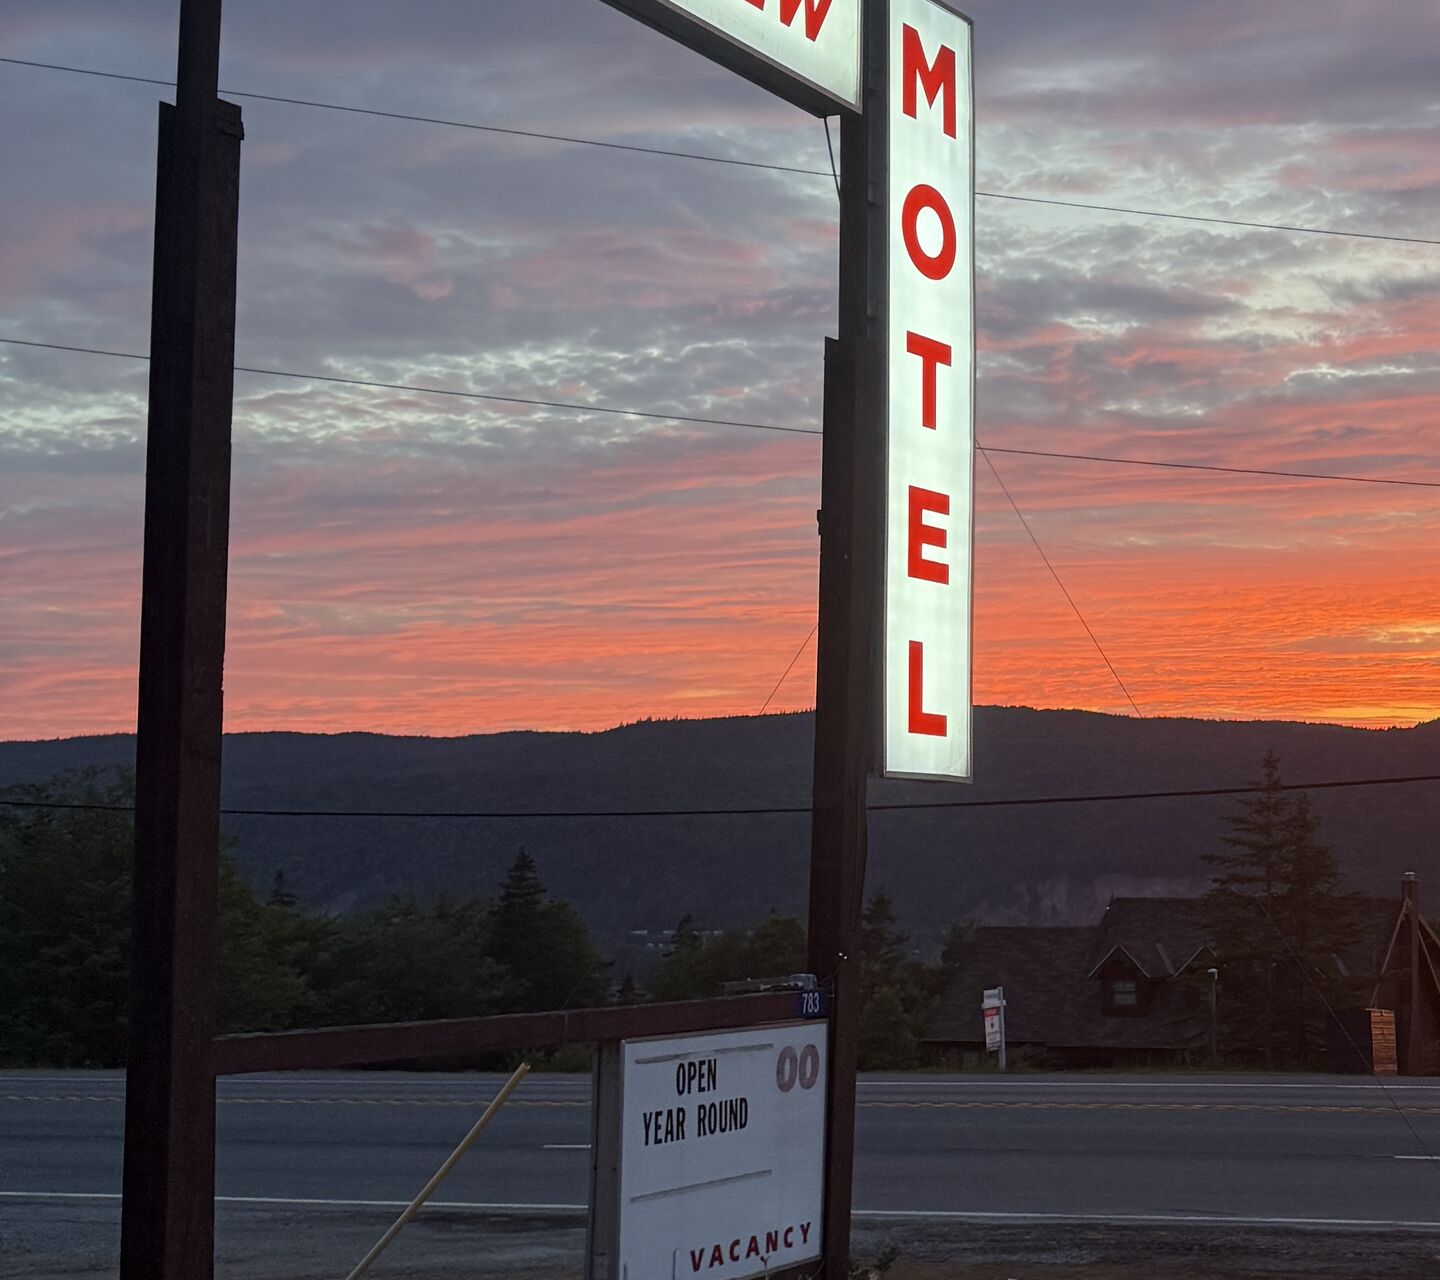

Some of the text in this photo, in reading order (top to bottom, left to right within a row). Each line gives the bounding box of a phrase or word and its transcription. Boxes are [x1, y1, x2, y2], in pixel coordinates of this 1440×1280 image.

[901, 22, 957, 738] MOTEL
[802, 992, 820, 1014] 783
[676, 1058, 717, 1095] OPEN
[643, 1097, 748, 1146] YEAR ROUND
[690, 1222, 811, 1272] VACANCY
